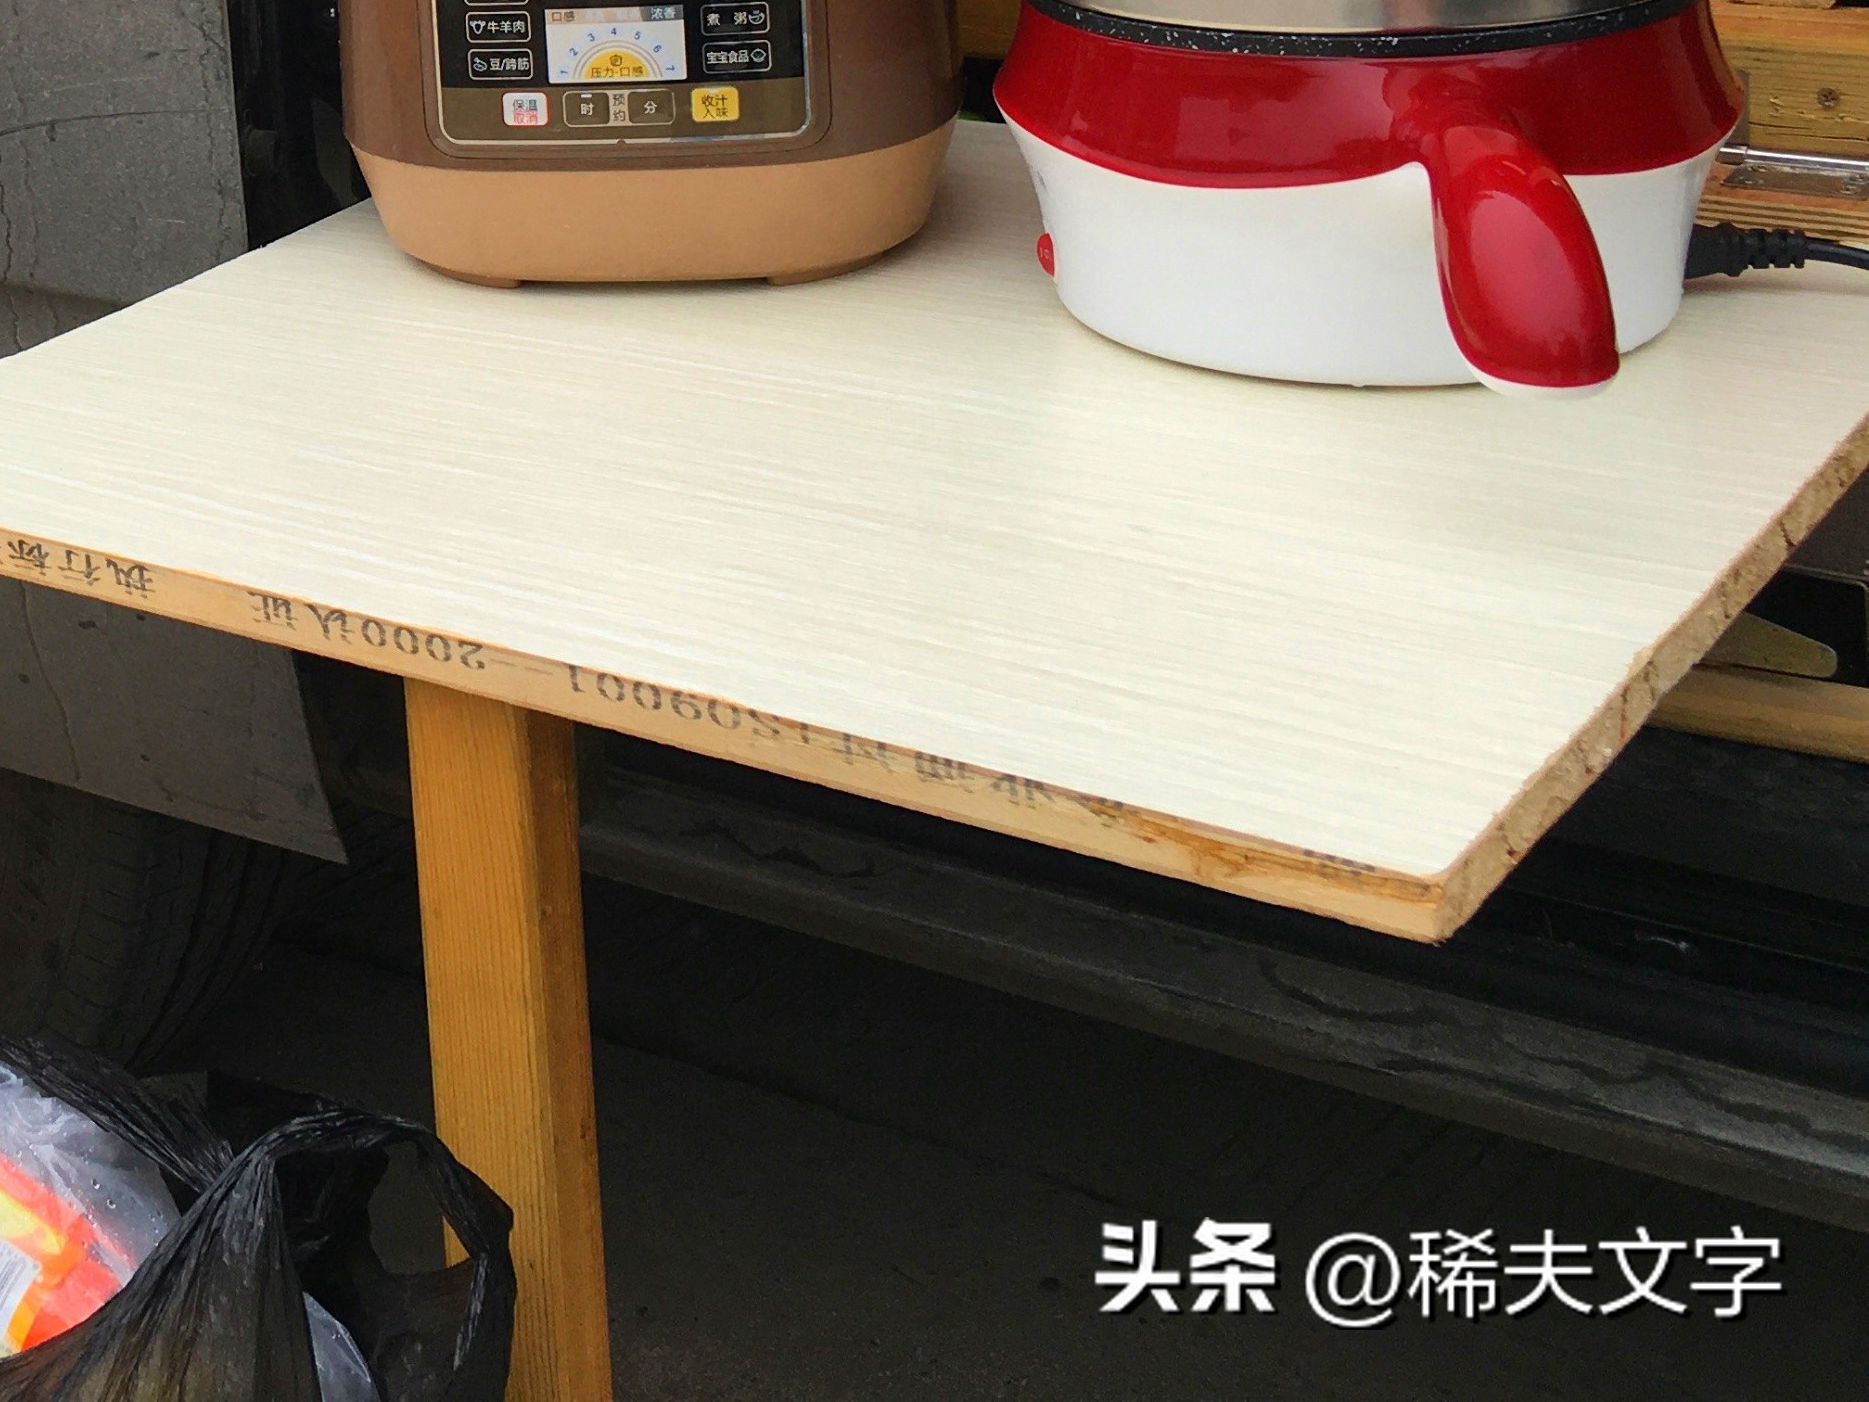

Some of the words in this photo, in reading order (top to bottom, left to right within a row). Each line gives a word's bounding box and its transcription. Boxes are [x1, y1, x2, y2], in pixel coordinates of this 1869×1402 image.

[487, 20, 526, 34] 牛羊肉
[706, 49, 750, 65] 宝宝食品
[643, 100, 658, 114] 分
[701, 94, 728, 107] 收汁
[580, 103, 595, 116] 时
[703, 107, 729, 119] 入味
